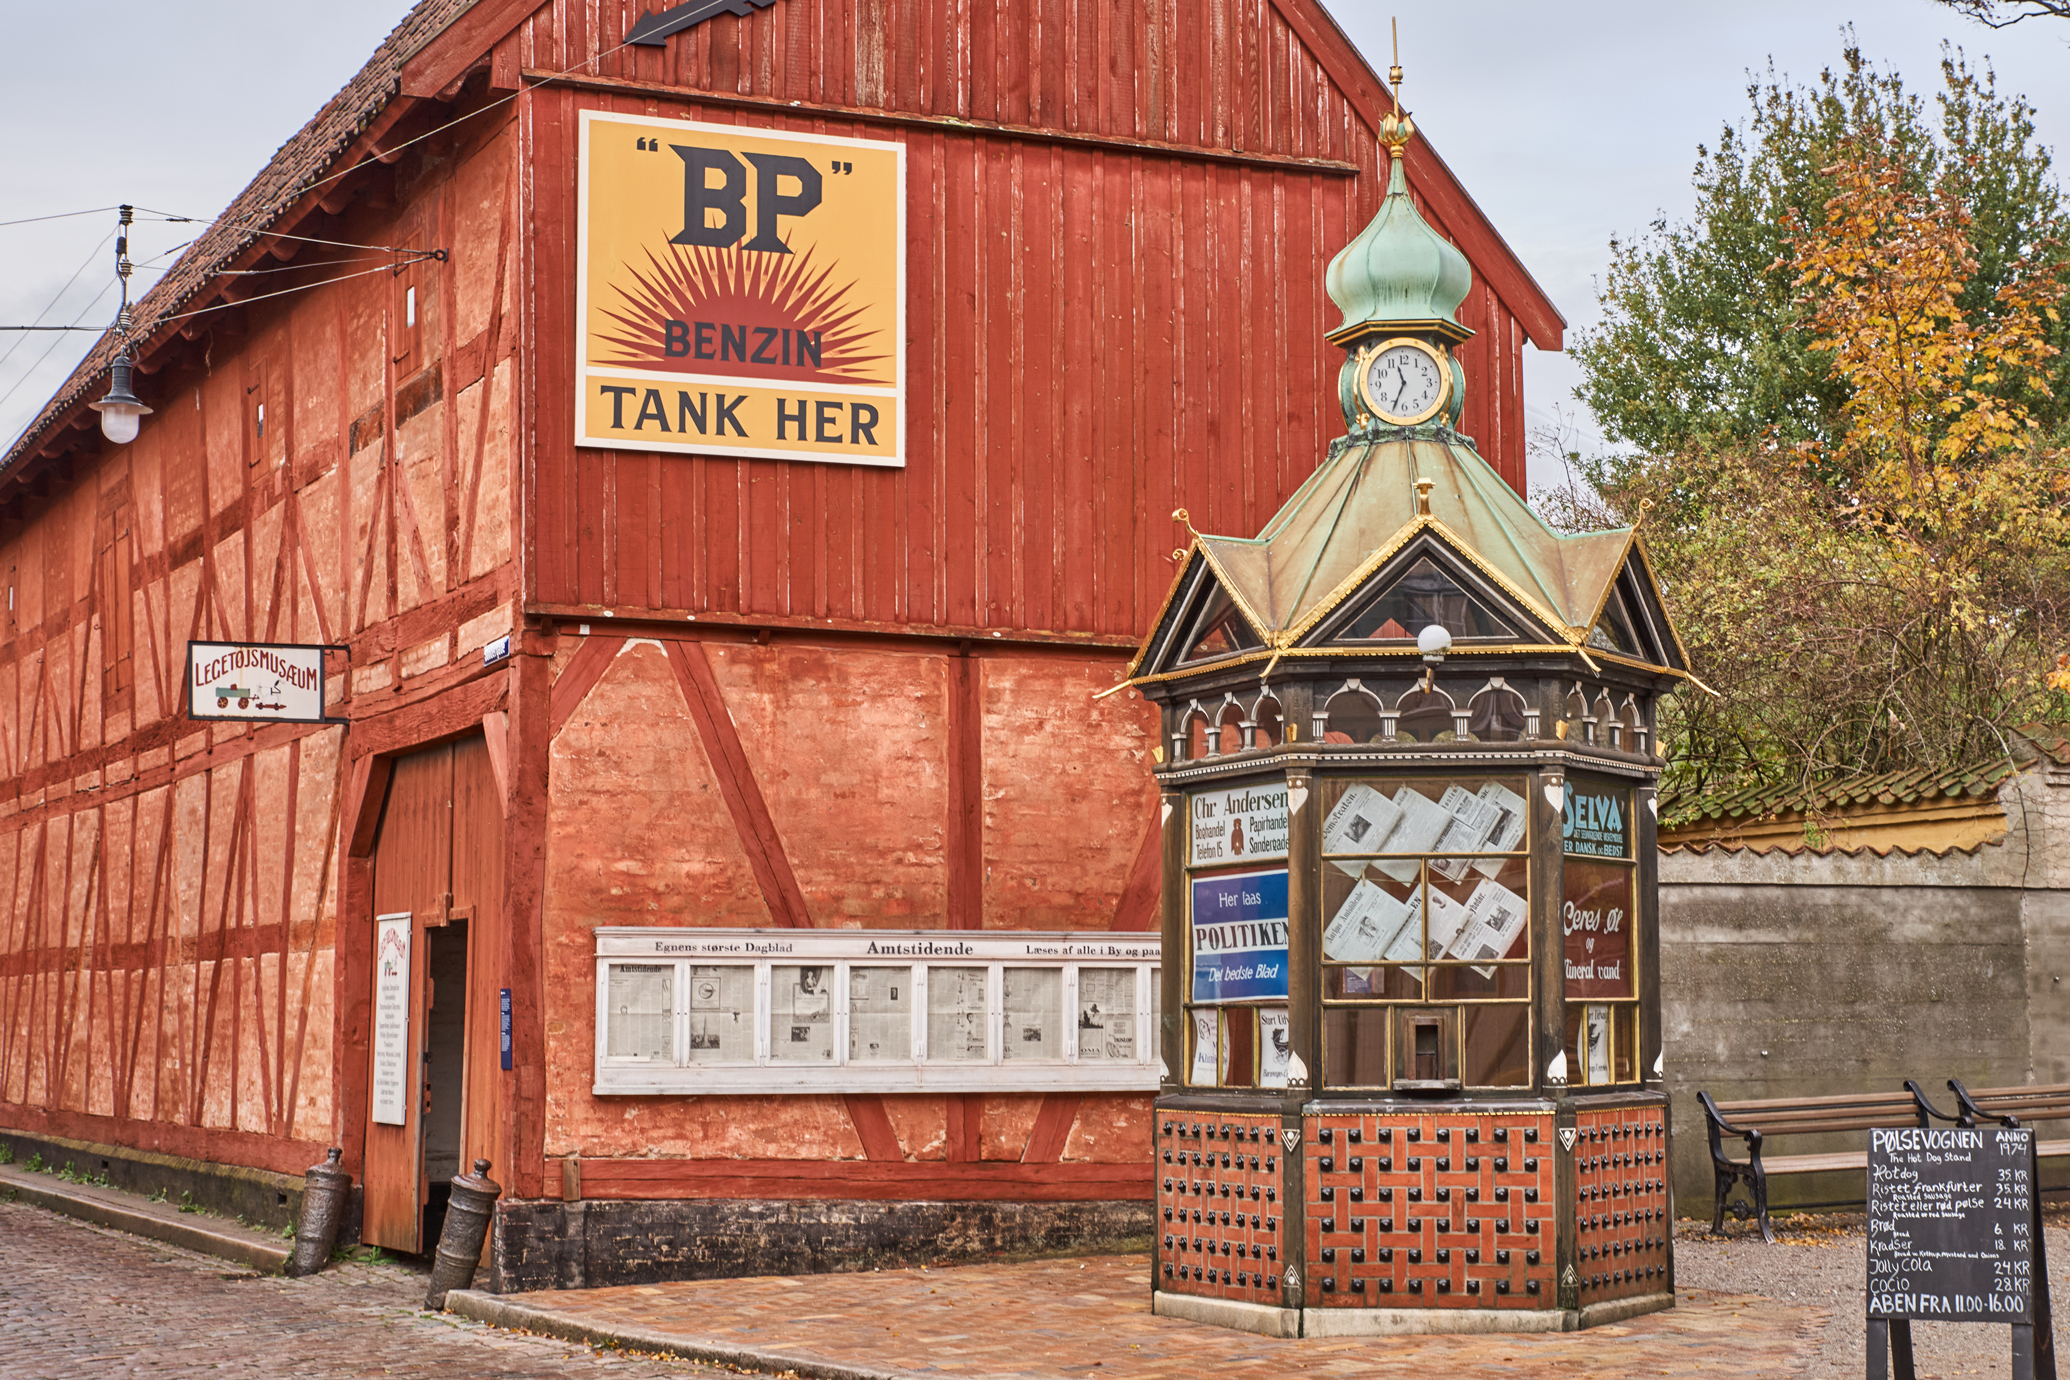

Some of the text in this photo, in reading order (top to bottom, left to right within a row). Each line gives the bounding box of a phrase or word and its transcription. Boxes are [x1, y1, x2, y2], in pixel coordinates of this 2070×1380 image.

[664, 318, 822, 368] BENZIN
[1387, 358, 1395, 369] 11
[1399, 354, 1409, 366] 12
[1414, 358, 1419, 368] 1
[1377, 368, 1388, 379] 10
[1421, 366, 1428, 377] 2
[1375, 380, 1382, 391] 9
[1426, 377, 1433, 388] 3
[1380, 391, 1388, 402] 8
[1421, 389, 1429, 400] 4
[1401, 401, 1408, 412] 6
[1412, 398, 1419, 409] 5
[600, 384, 880, 447] TANK HER
[195, 649, 318, 692] LEGETØJSMUSÆUM
[1195, 790, 1288, 820] Chr. Andersen
[1563, 780, 1623, 838] SELVA
[1195, 819, 1226, 840] Boghandel
[1249, 811, 1288, 837] Papirhande
[1196, 841, 1223, 860] Telefon 15
[1563, 839, 1574, 853] ER
[1575, 841, 1597, 855] DANSK
[1603, 844, 1623, 857] BEDST
[1218, 892, 1239, 908] Her
[1563, 900, 1624, 937] Ceres Øl
[655, 941, 793, 955] Egnens største Dagblad
[866, 940, 974, 956] Amtstidende
[1026, 945, 1160, 957] Læses af alle i By og paa
[1585, 937, 1595, 954] og
[1208, 963, 1279, 982] Det bedste Blad
[1597, 959, 1621, 980] vand
[1872, 1129, 1983, 1154] PØLSEVOGNEN
[1995, 1130, 2029, 1143] ANNO
[1999, 1142, 2027, 1156] 1974
[1889, 1151, 1972, 1165] The Hot Dog Stand
[2014, 1168, 2029, 1183] KR
[1872, 1182, 1911, 1199] Ristet
[1912, 1180, 1983, 1195] frankfurter
[2014, 1182, 2029, 1197] KR
[1893, 1193, 1922, 1203] Roasted
[1871, 1199, 1908, 1217] Ristet
[1909, 1200, 1933, 1212] eller
[1935, 1199, 1953, 1211] rød
[2013, 1197, 2030, 1212] KR
[1870, 1218, 1896, 1238] Brød
[2013, 1222, 2030, 1237] KR
[2013, 1239, 2029, 1253] KR
[1869, 1258, 1900, 1280] Jolly
[1901, 1257, 1933, 1272] Cola
[2013, 1260, 2031, 1276] KR
[2013, 1276, 2031, 1297] KR
[1919, 1292, 1952, 1314] FRA
